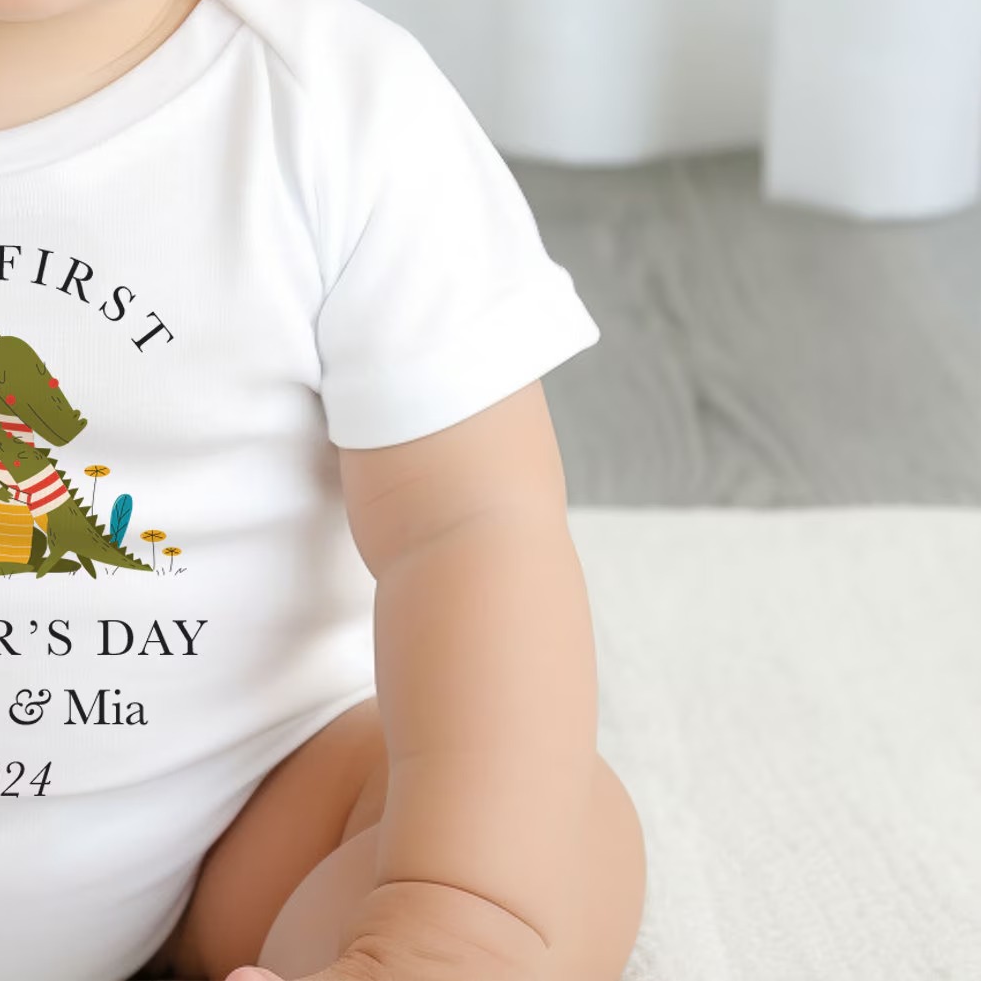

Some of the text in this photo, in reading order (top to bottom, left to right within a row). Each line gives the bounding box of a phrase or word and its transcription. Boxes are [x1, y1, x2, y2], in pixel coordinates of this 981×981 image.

[96, 619, 208, 656] DAY
[8, 688, 52, 726] &
[63, 688, 149, 726] Mia
